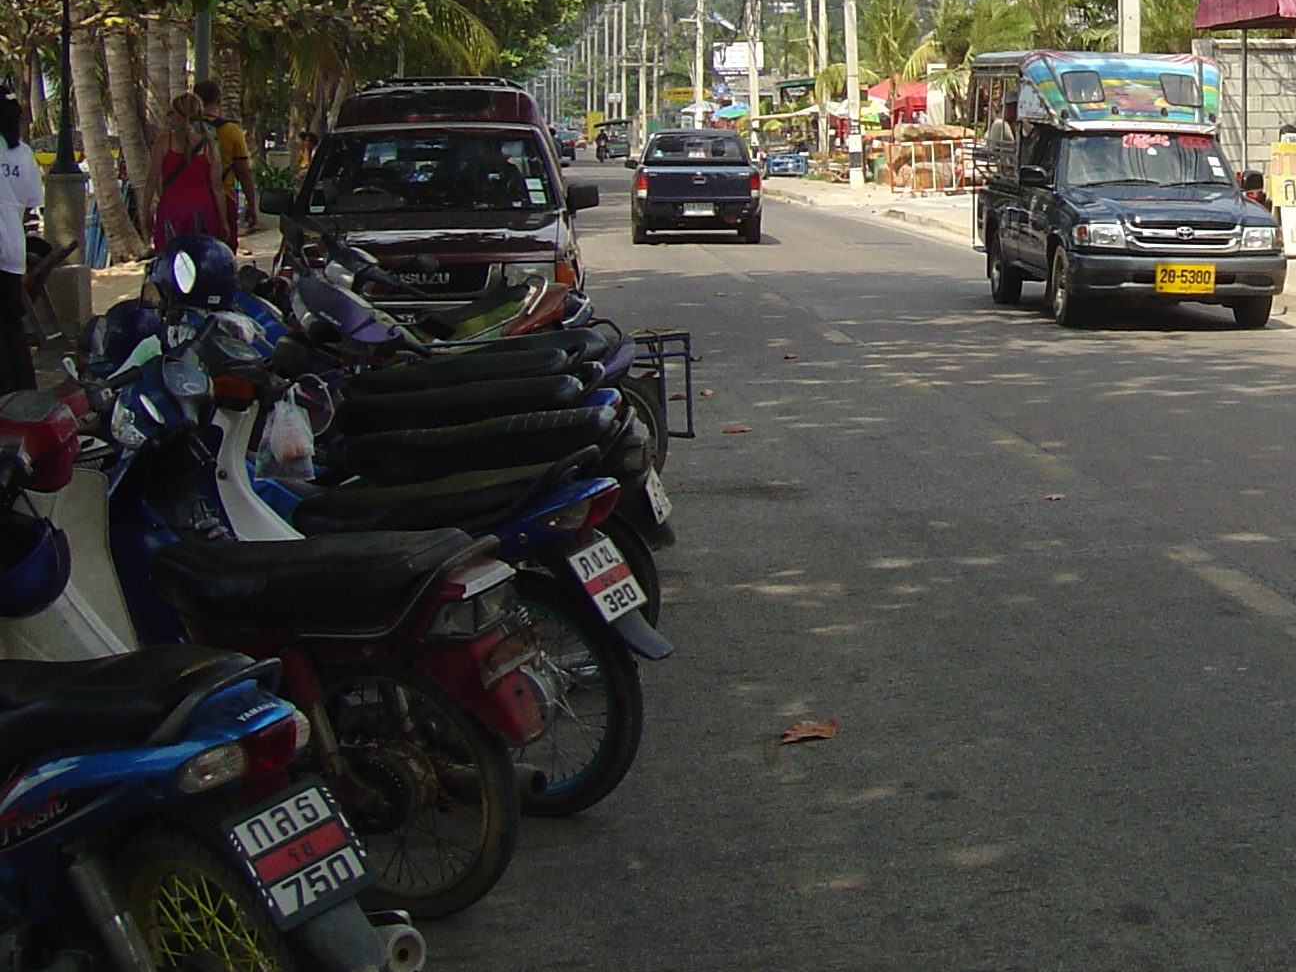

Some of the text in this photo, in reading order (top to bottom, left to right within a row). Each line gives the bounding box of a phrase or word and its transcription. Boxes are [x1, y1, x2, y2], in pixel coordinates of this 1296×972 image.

[603, 582, 637, 613] 320
[237, 701, 280, 722] YAMAHA
[281, 853, 356, 907] 750
